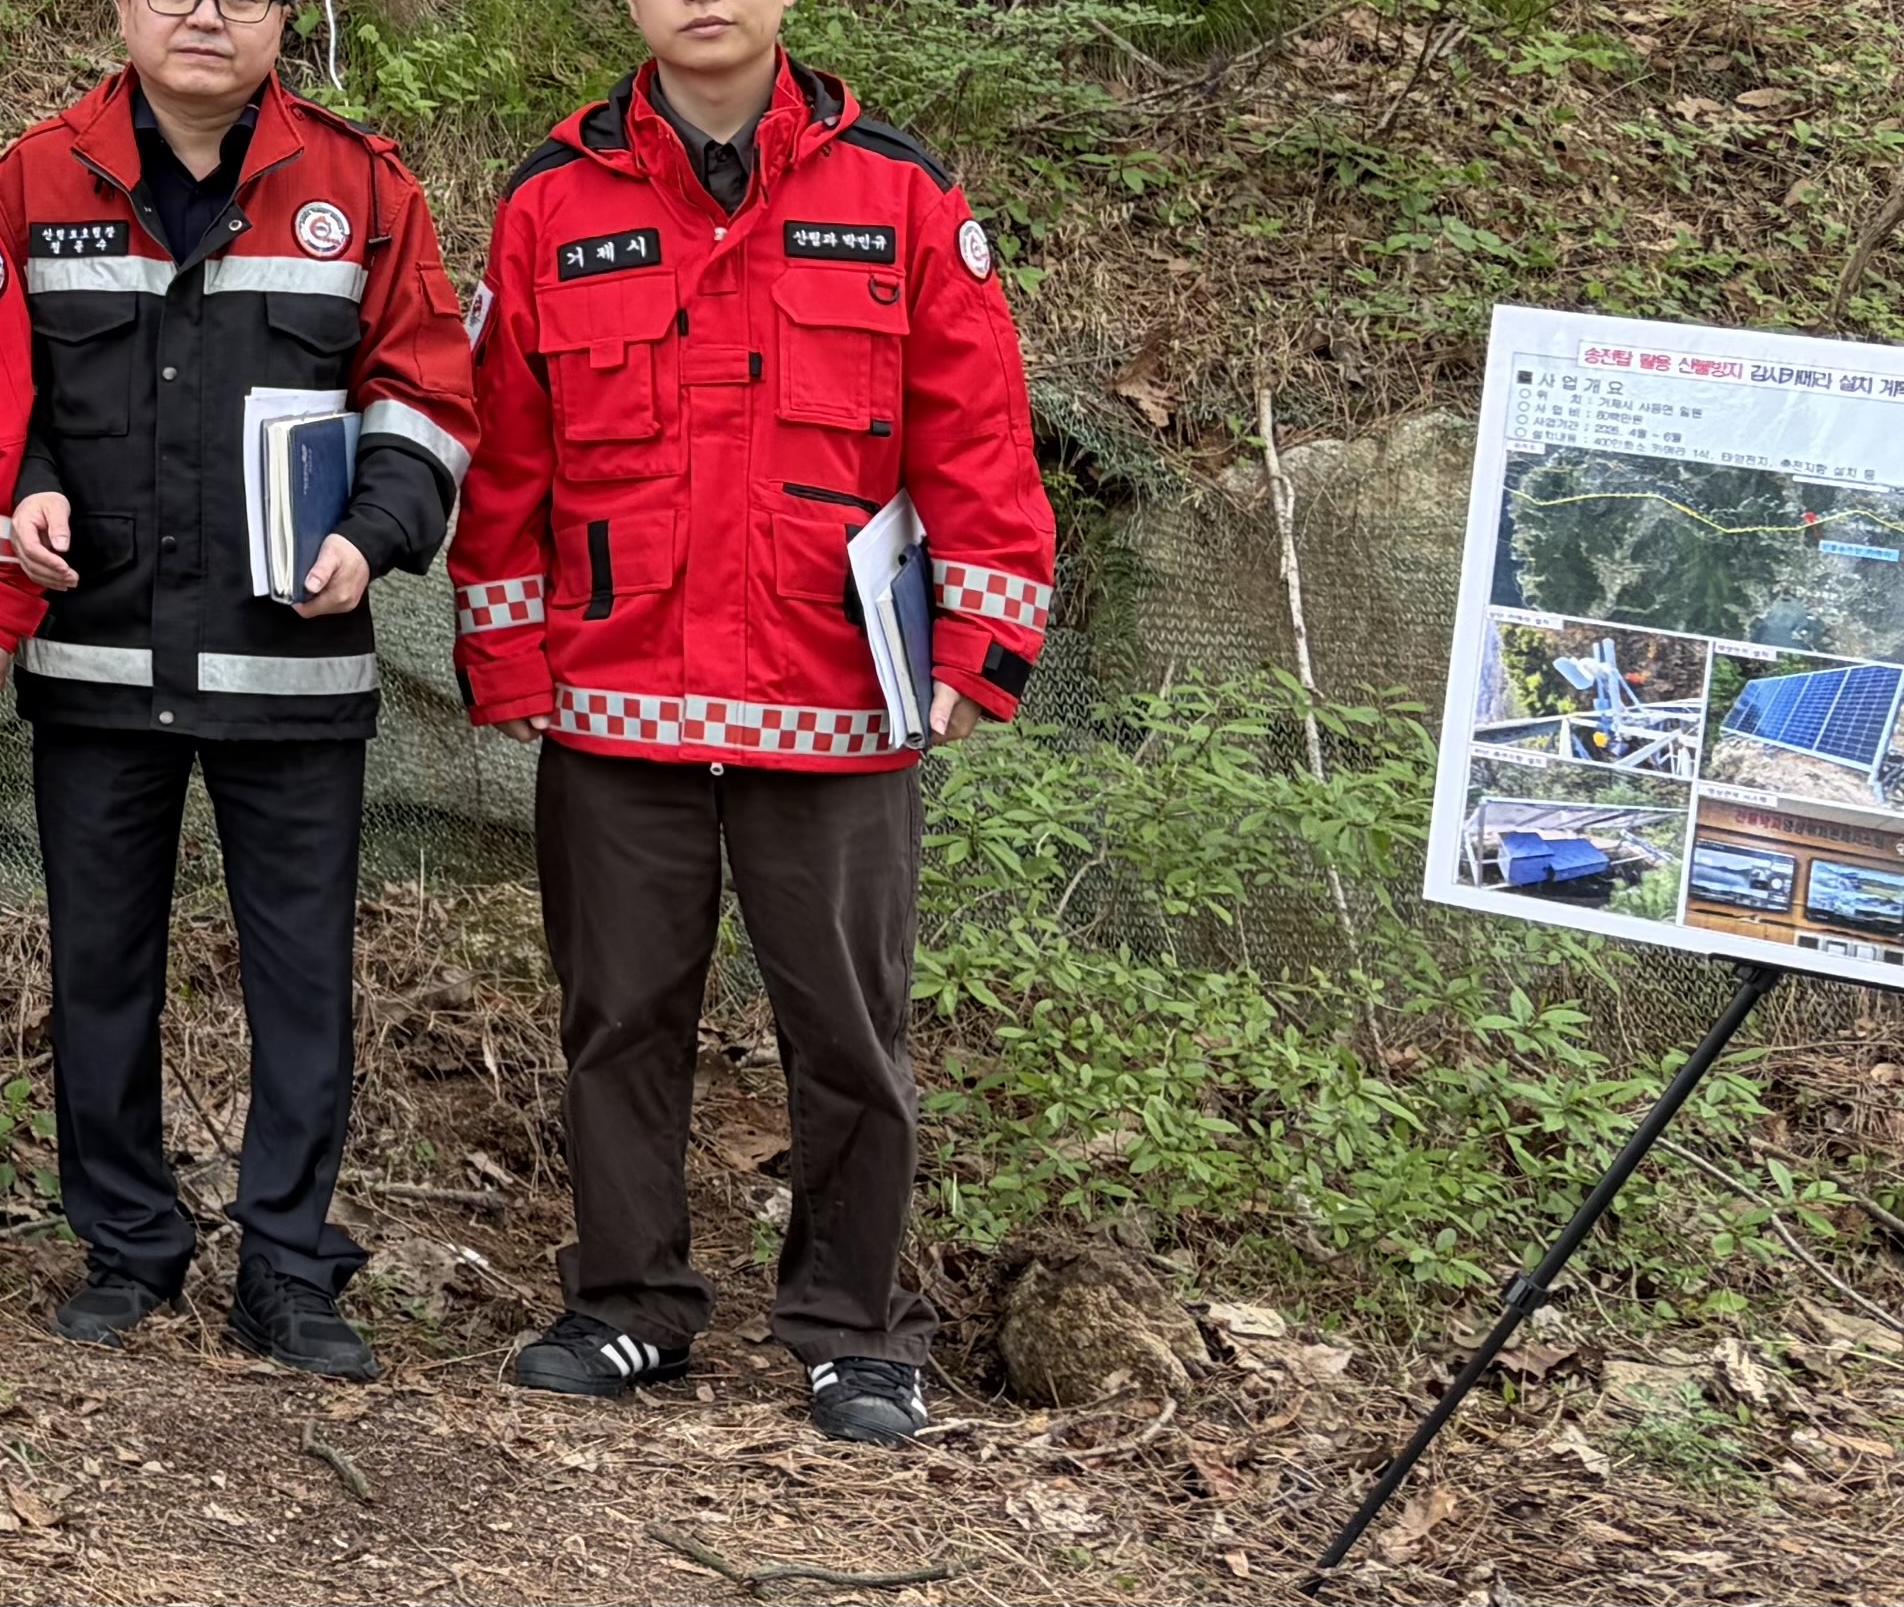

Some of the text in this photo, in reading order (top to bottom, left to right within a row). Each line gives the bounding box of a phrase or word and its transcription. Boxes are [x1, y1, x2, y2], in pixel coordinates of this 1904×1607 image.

[566, 235, 647, 268] 거제시
[1584, 347, 1634, 368] 송전탑
[1839, 375, 1873, 395] 설치
